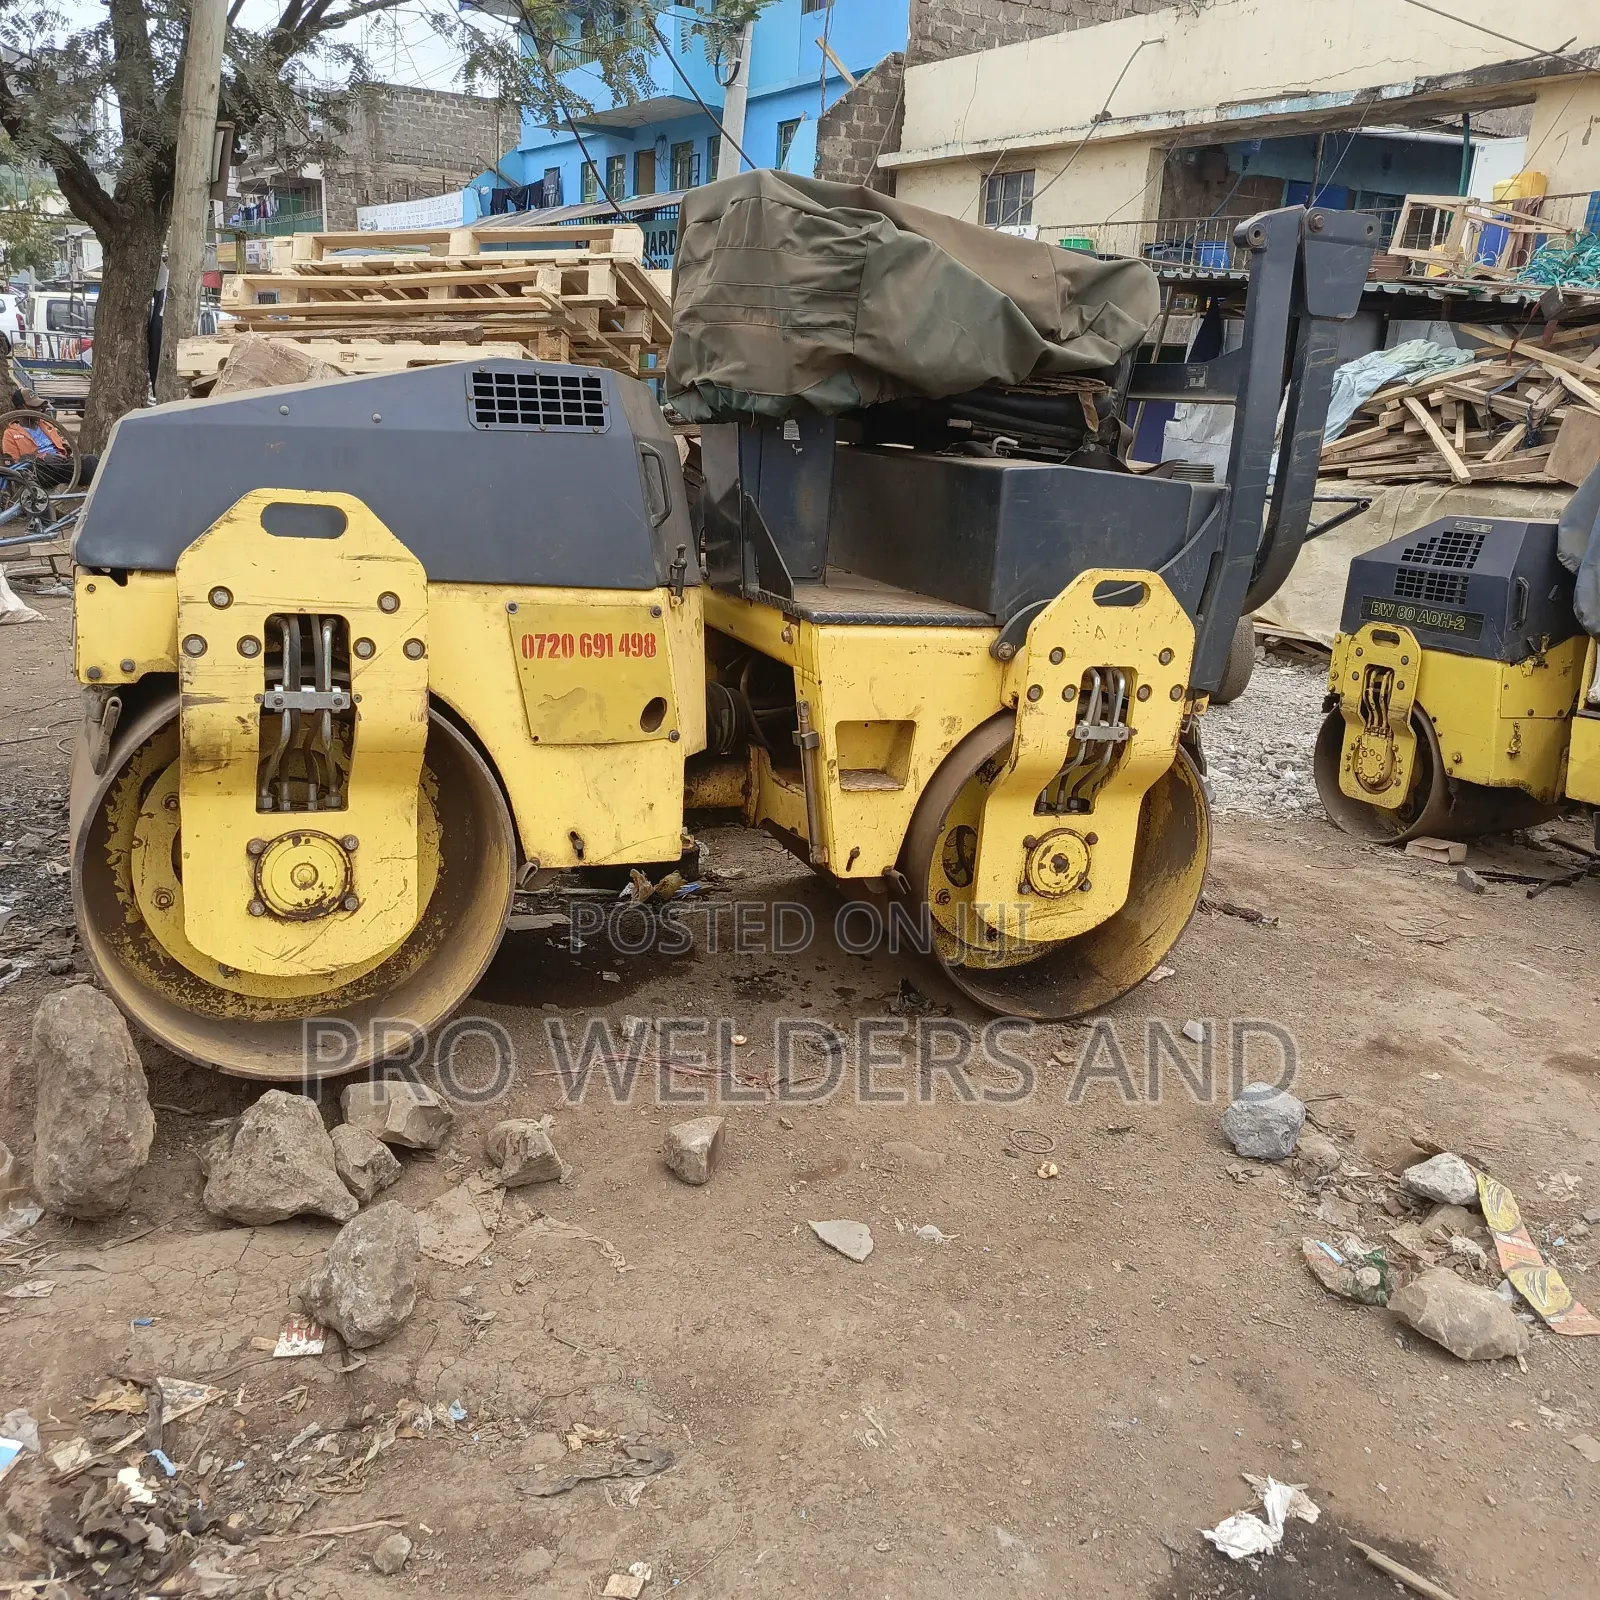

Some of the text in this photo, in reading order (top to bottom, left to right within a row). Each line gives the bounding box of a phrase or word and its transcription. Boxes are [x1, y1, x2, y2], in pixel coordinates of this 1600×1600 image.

[1371, 601, 1466, 630] BW 80 ADH-2
[521, 632, 657, 659] 0720 691 498
